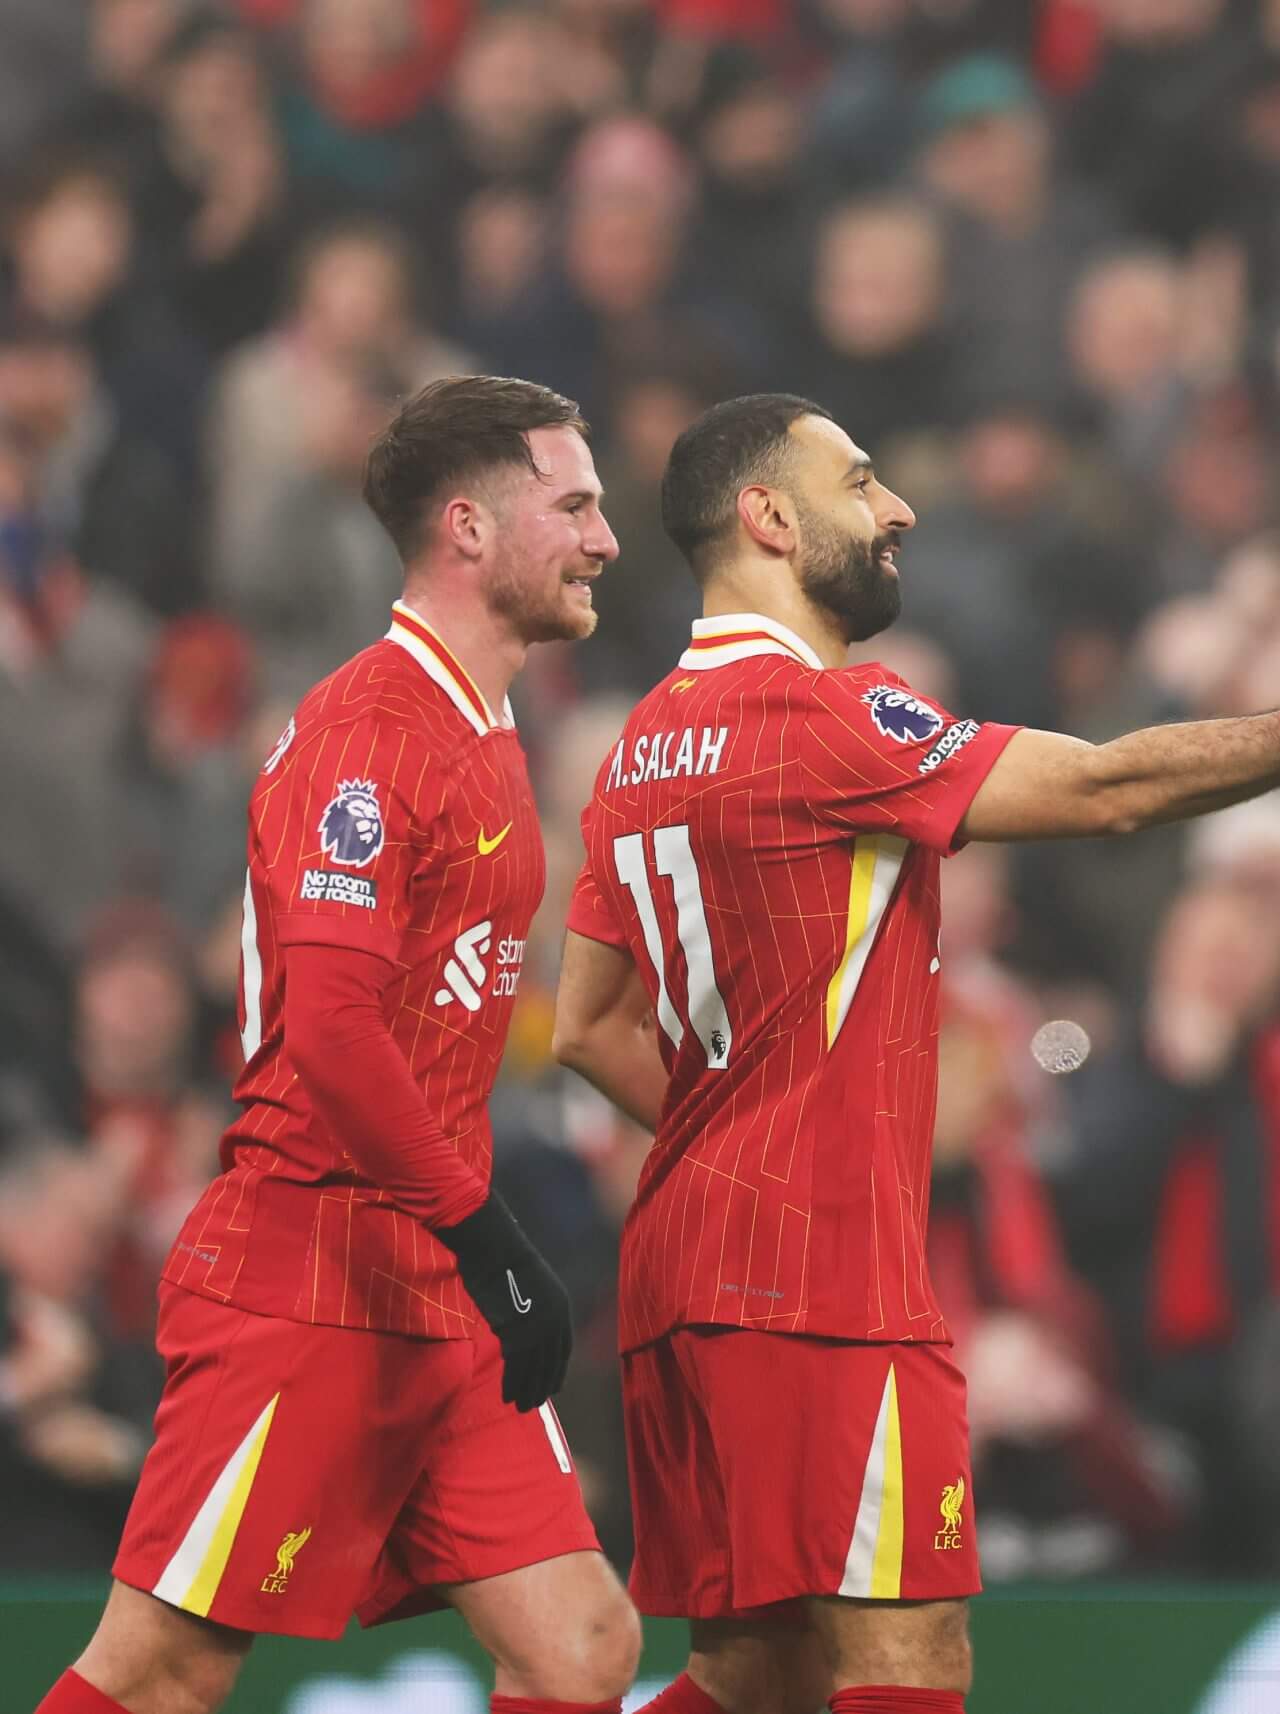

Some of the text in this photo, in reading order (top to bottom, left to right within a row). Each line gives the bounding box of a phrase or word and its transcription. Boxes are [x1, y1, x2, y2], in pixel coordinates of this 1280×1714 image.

[303, 869, 371, 895] No room
[613, 824, 732, 1070] 11
